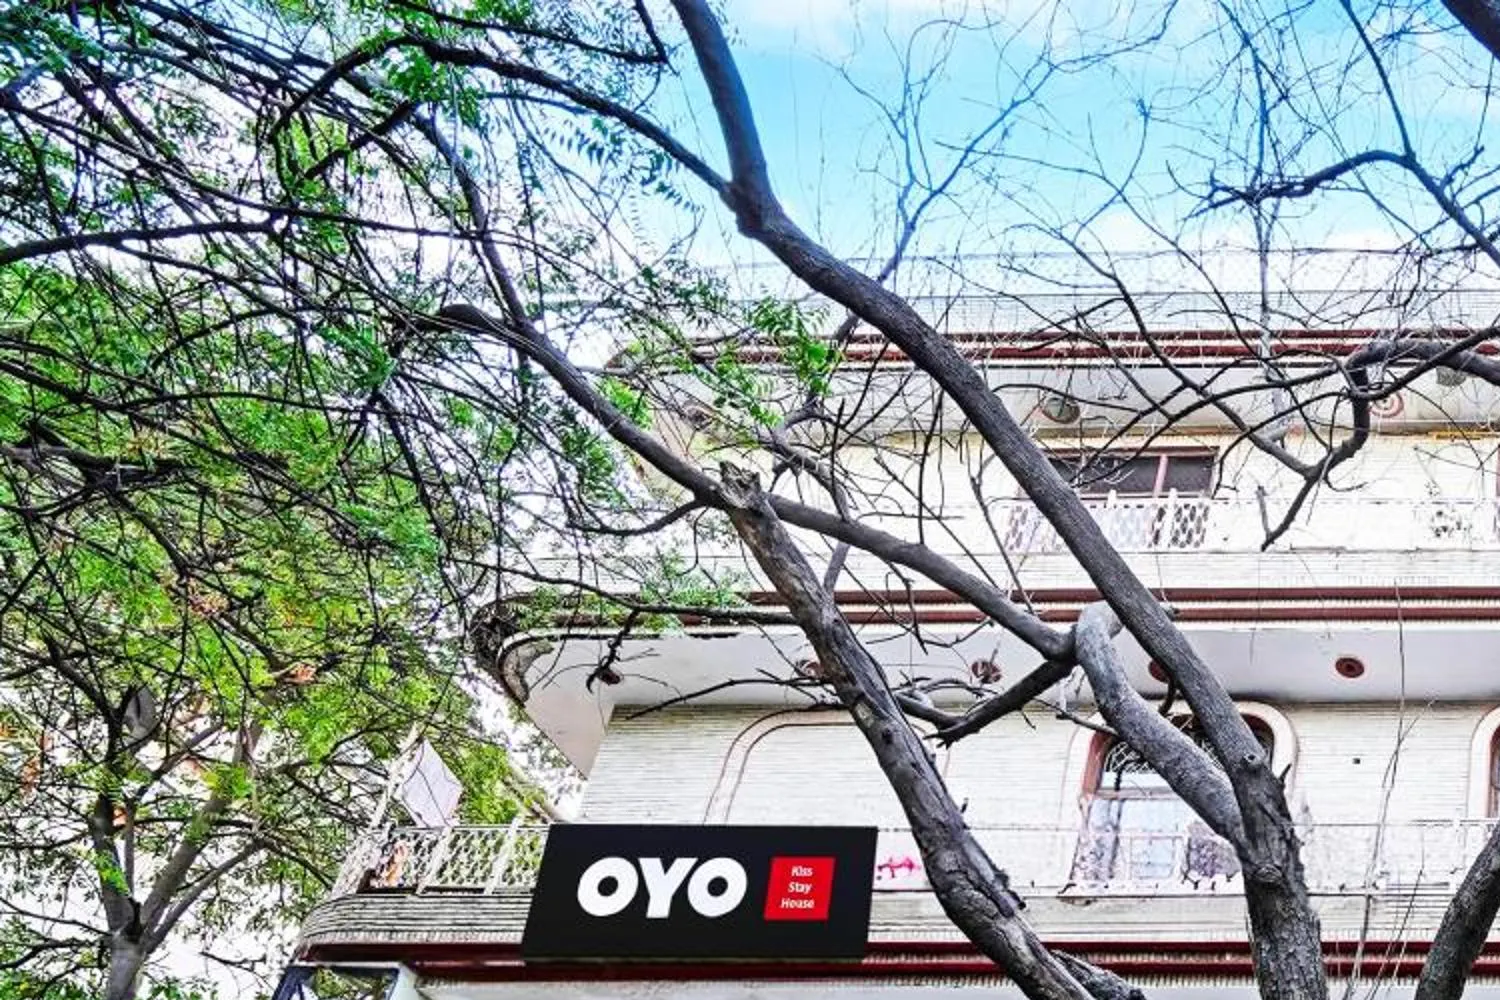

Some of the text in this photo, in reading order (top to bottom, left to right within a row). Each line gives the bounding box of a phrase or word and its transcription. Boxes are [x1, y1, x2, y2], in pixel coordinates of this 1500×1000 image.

[791, 865, 813, 877] Kiss
[577, 856, 748, 918] OYO
[788, 881, 812, 895] Stay
[780, 897, 815, 909] House
